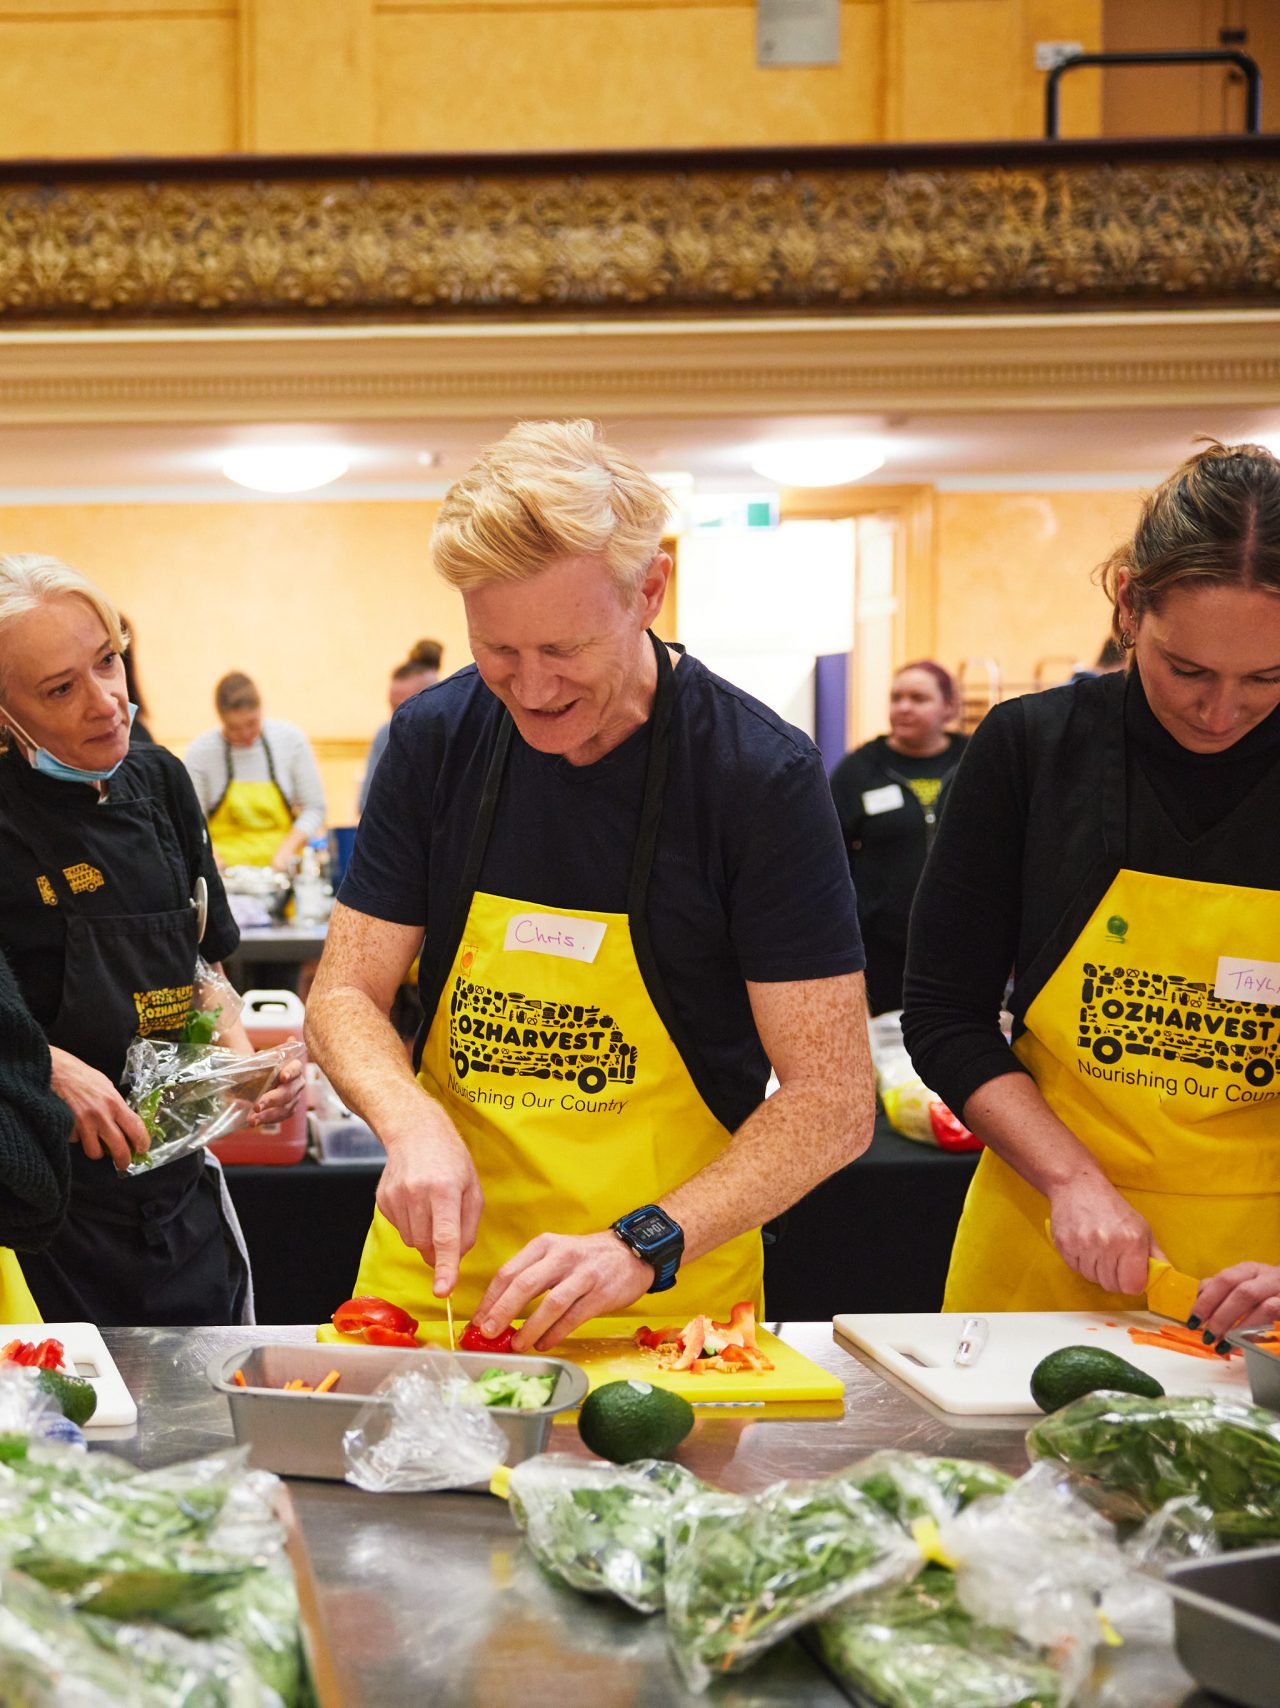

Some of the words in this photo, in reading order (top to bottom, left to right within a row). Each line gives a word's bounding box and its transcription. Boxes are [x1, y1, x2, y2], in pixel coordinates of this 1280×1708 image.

[1227, 969, 1280, 994] TAYL
[458, 1014, 606, 1051] OZHARVEST
[1101, 998, 1275, 1041] OZHARVEST
[1078, 1059, 1178, 1096] Nourishing
[1184, 1077, 1219, 1100] Our
[1225, 1084, 1280, 1102] Coun
[521, 1092, 556, 1108] Our
[560, 1094, 629, 1115] Country
